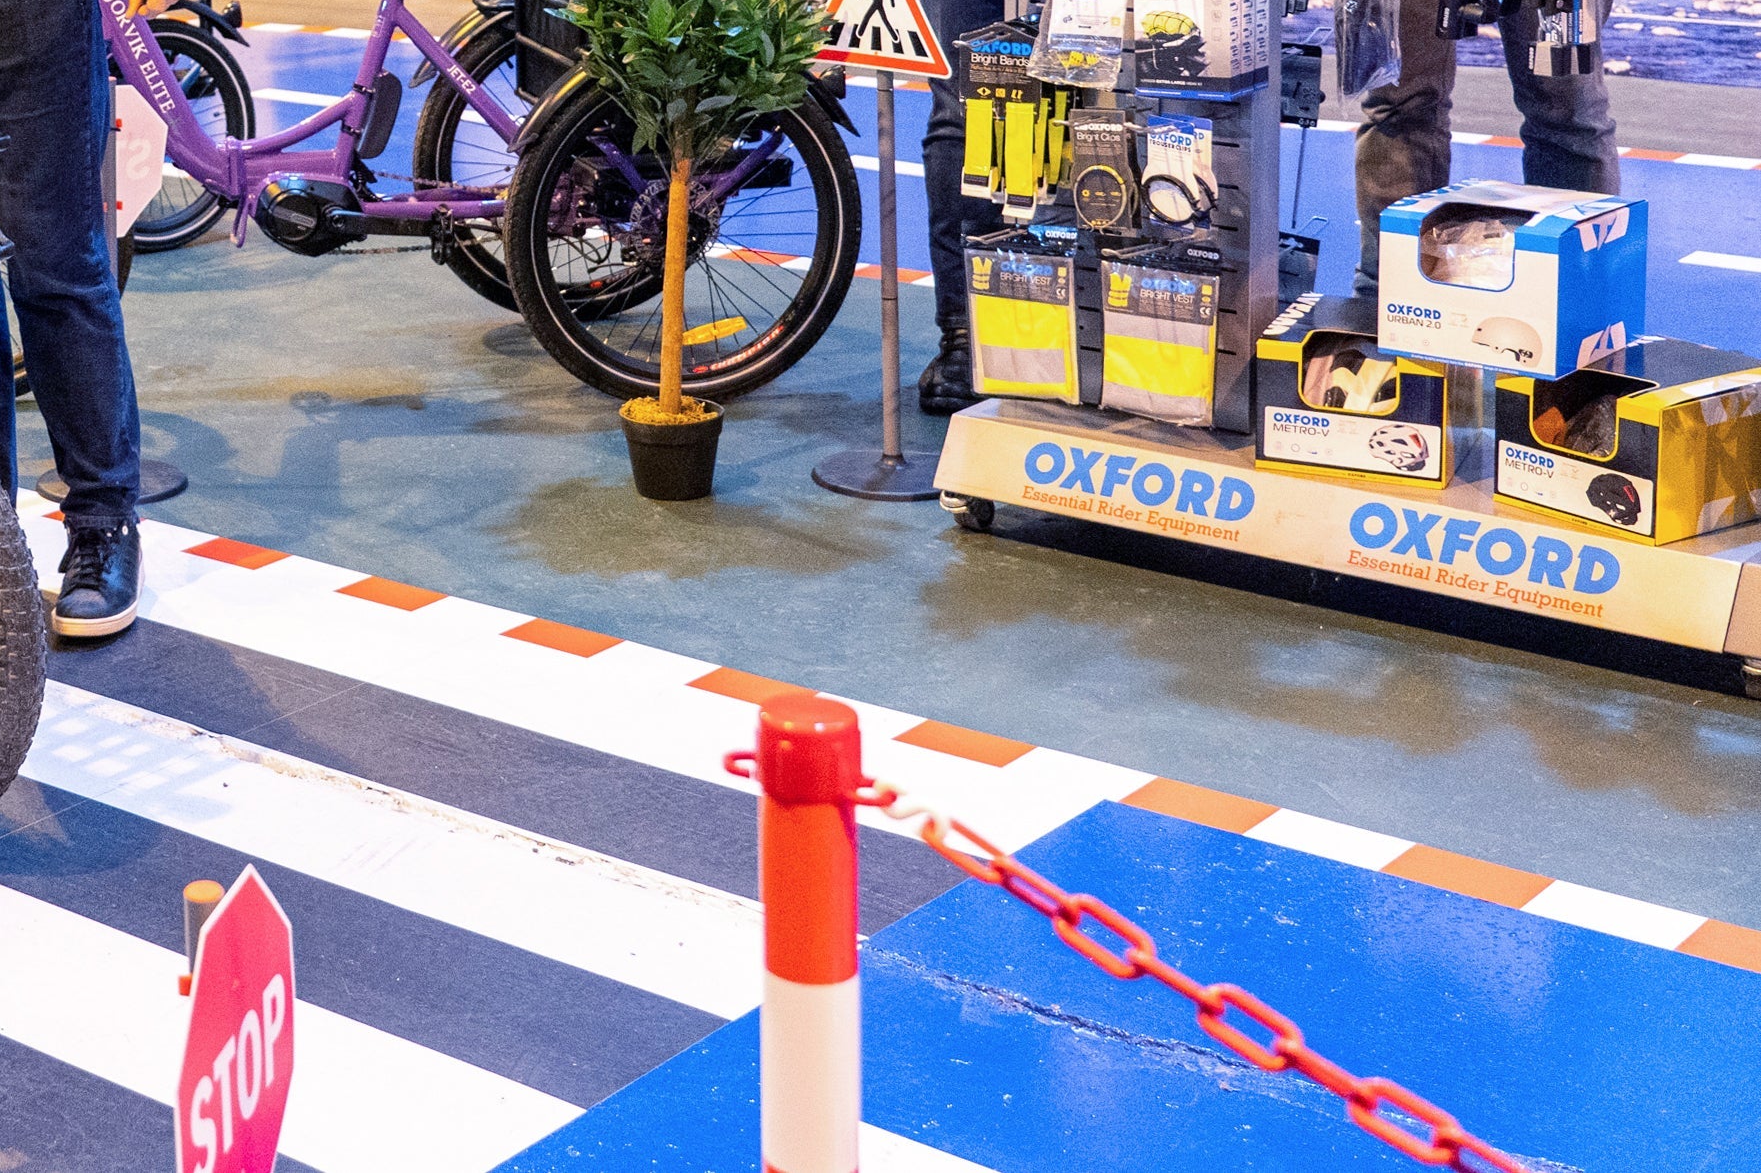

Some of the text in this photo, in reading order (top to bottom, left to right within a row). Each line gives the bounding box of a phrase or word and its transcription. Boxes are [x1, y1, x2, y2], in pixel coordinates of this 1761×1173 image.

[970, 39, 1033, 57] OXFORD
[971, 53, 1030, 67] Bright Bands
[140, 60, 176, 114] ELITE
[447, 64, 476, 94] JET-E2
[1088, 123, 1123, 132] OXFORD
[1076, 133, 1121, 142] Bright Clips
[1150, 132, 1192, 147] OXFORD
[1149, 139, 1192, 153] TROUSER CLIPS
[1045, 230, 1078, 239] OXFORD
[1187, 248, 1219, 260] OXFORD
[1000, 272, 1052, 285] BRIGHT VEST
[1140, 289, 1195, 304] BRIGHT VEST
[1387, 303, 1442, 320] OXFORD
[1387, 314, 1442, 330] URBAN 2.0
[1273, 412, 1330, 427] OXFORD
[1273, 423, 1330, 437] METRO-V
[1505, 447, 1555, 469] OXFORD
[1504, 457, 1555, 479] METRO-V
[1024, 442, 1255, 522] OXFORD
[1022, 485, 1240, 543] Essential Rider Equipment
[1349, 502, 1621, 595] OXFORD
[1347, 550, 1604, 619] Essential Rider Equipment
[190, 973, 286, 1173] STOP
